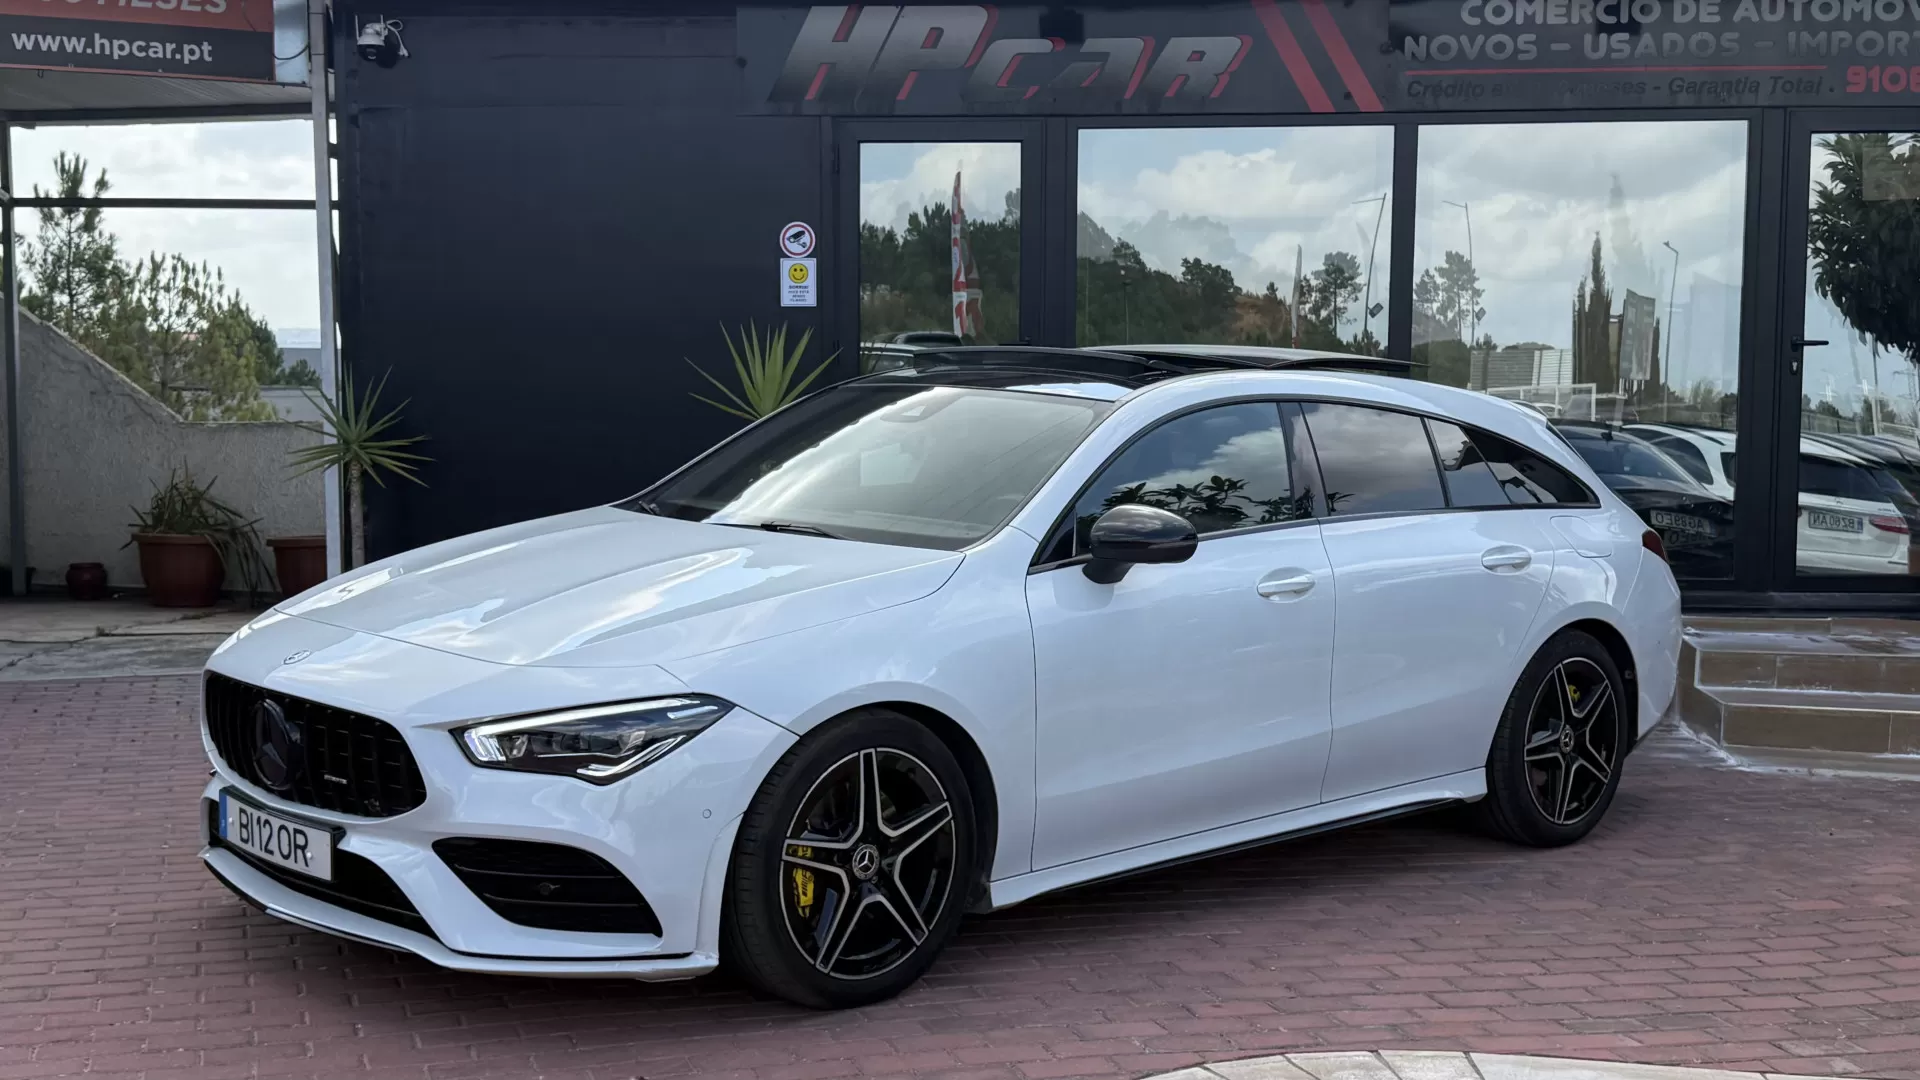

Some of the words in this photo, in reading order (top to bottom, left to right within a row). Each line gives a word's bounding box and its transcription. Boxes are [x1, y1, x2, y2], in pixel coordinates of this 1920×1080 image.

[1673, 0, 1721, 23] DE
[11, 32, 213, 64] www.hpcar.pt
[1404, 34, 1538, 61] NOVOS
[1583, 32, 1741, 59] USADOS
[1668, 76, 1760, 97] Garantia
[238, 806, 310, 868] BI12OR
